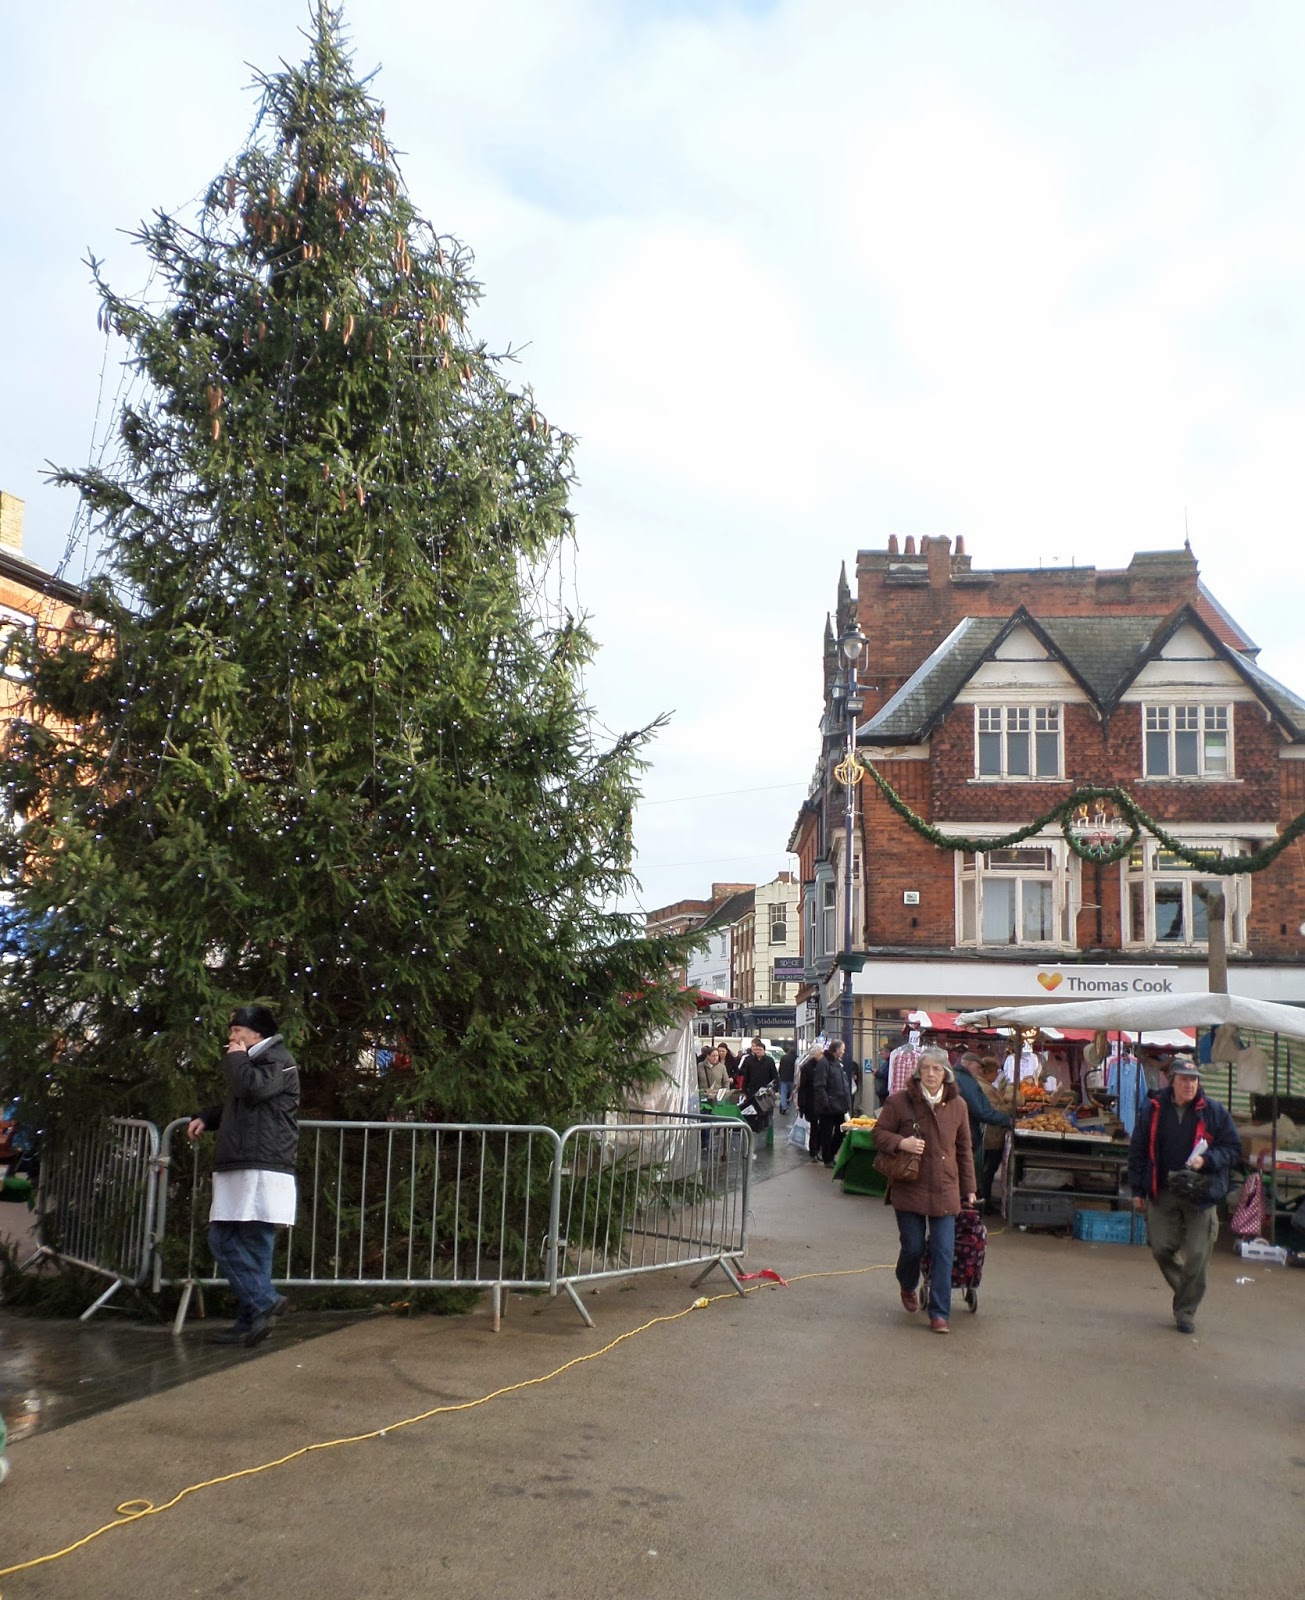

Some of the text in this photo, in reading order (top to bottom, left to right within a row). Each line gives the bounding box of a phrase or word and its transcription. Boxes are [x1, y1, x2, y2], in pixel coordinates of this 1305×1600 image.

[1067, 977, 1173, 993] Thomas Cook
[756, 1017, 795, 1025] Middletons
